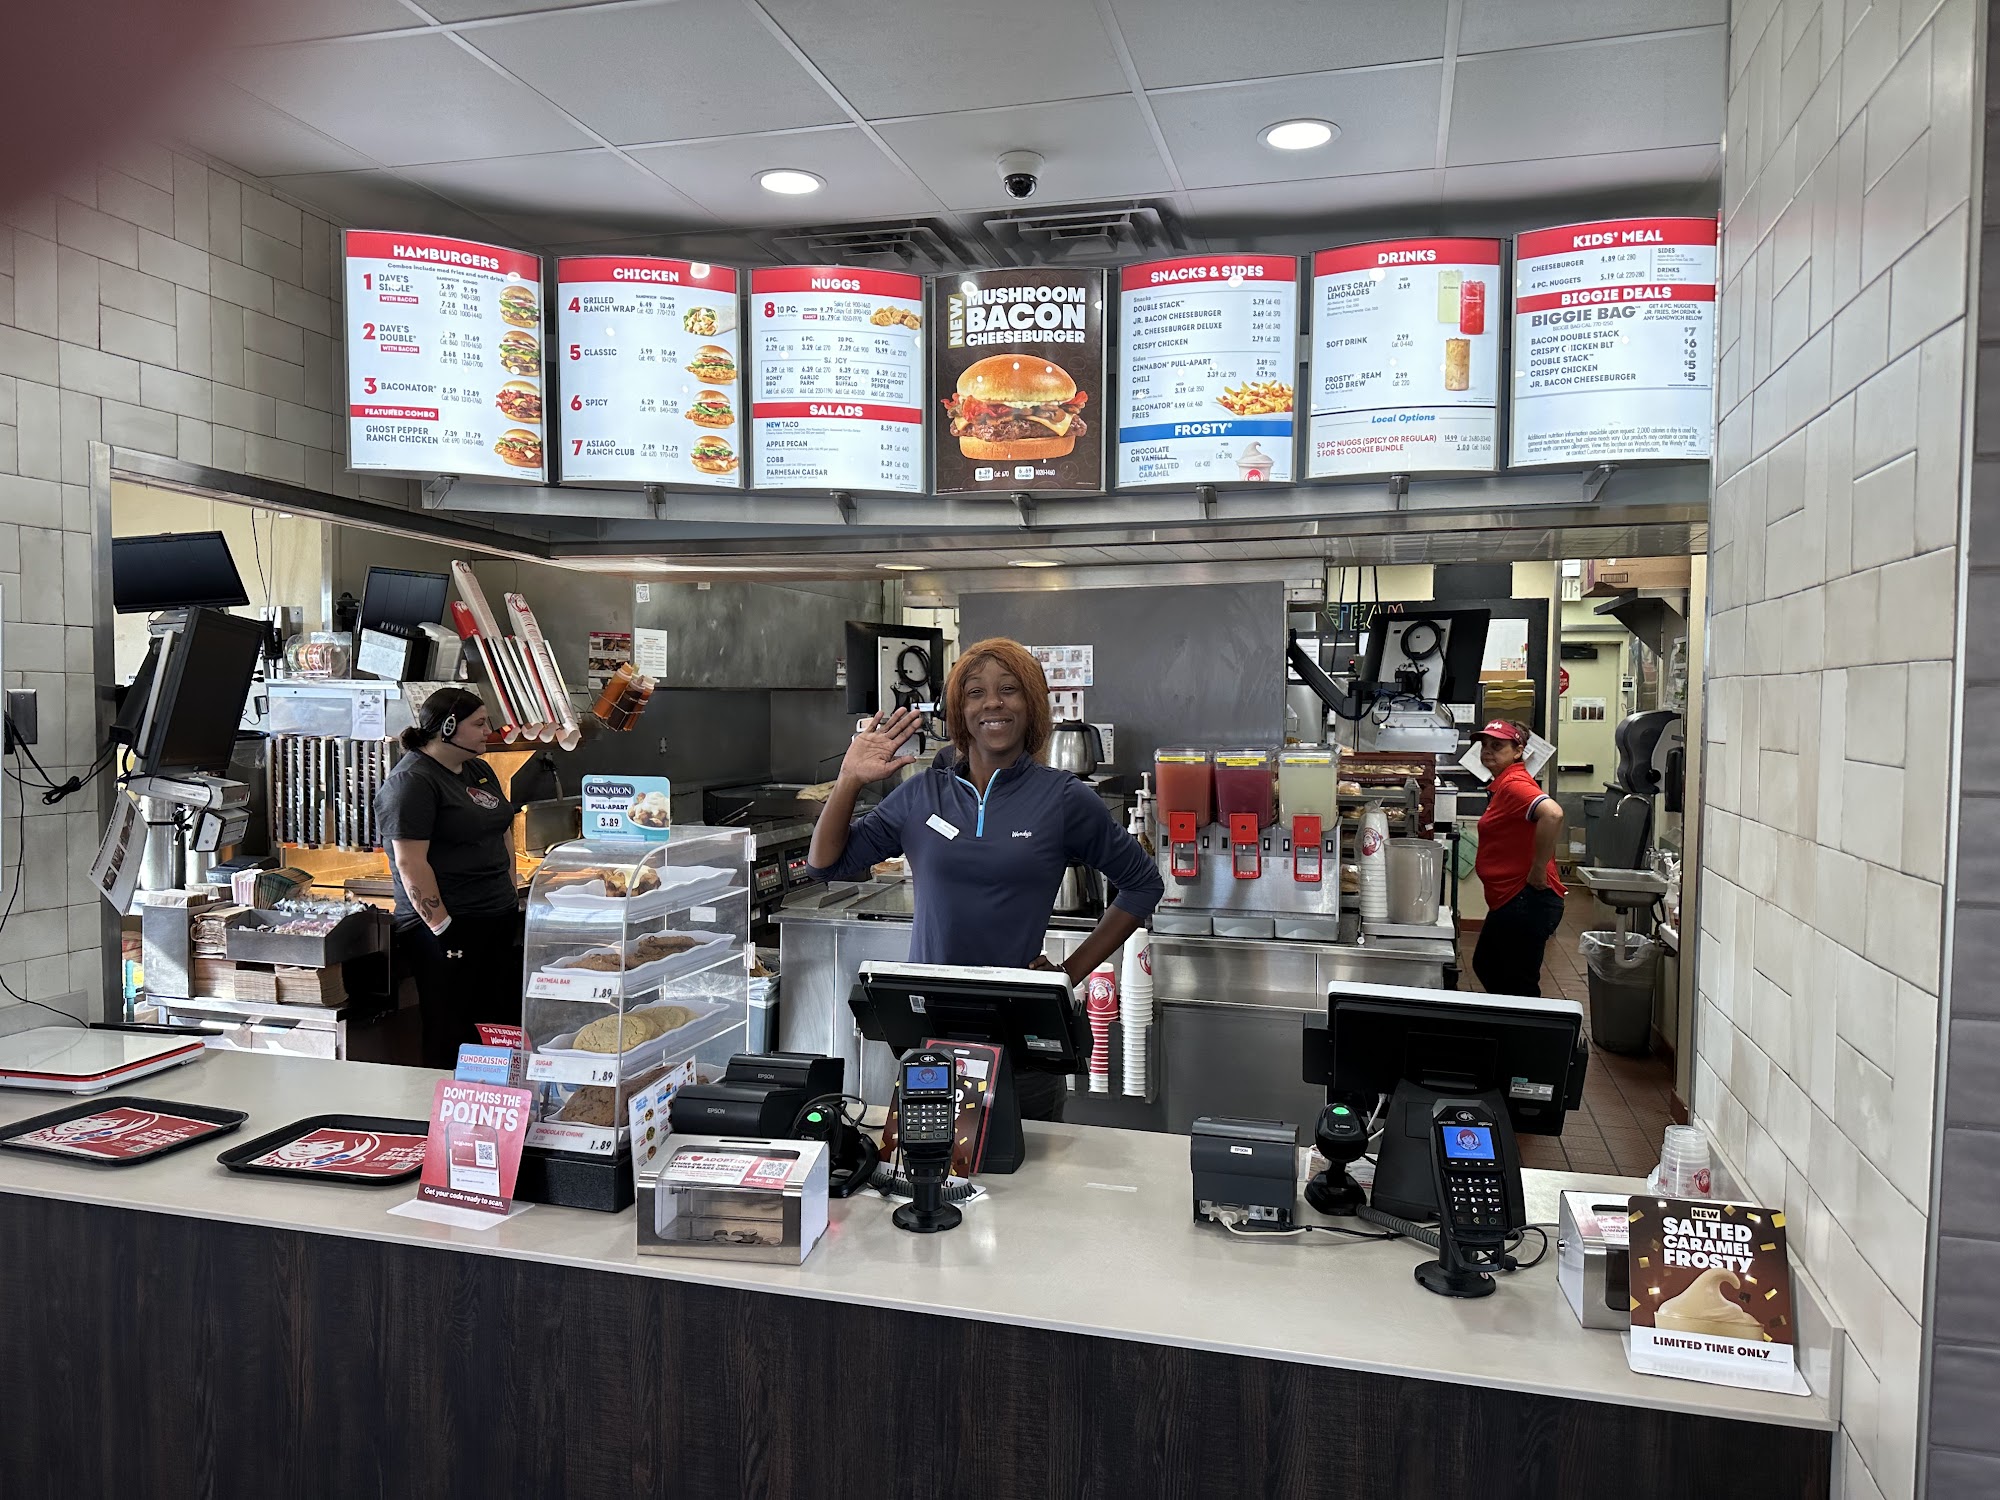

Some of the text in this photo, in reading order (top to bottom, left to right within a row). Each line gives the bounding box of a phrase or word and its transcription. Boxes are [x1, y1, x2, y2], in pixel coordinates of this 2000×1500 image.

[1573, 230, 1663, 248] KIDS' MEAL
[393, 245, 499, 269] HAMBURGERS
[1378, 250, 1436, 264] DRINKS
[451, 268, 465, 276] fries
[1531, 260, 1584, 272] CHEESEBURGER
[379, 274, 409, 282] DAVE'S
[613, 268, 679, 282] CHICKEN
[1151, 265, 1263, 283] SNACKS & SIDES
[363, 274, 371, 290] 1
[811, 278, 860, 290] NUGGS
[1328, 281, 1377, 293] DAVE'S CRAFT
[1550, 277, 1582, 287] NUGGETS
[967, 286, 1085, 306] MUSHROOM
[1328, 289, 1370, 300] LEMONADES
[1562, 287, 1672, 305] BIGGIE DEALS
[568, 297, 580, 313] 4
[764, 302, 775, 318] 8
[950, 298, 962, 345] NEW
[967, 303, 1085, 333] BACON
[1145, 314, 1167, 323] BACON
[1169, 310, 1222, 320] CHEESEBURGER
[1532, 306, 1636, 327] BIGGIE BAG
[363, 323, 375, 340] 2
[380, 324, 409, 333] DAVE'S
[1145, 324, 1195, 335] CHEESEBURGER
[1685, 327, 1696, 336] $7
[966, 330, 1085, 346] CHEESEBURGER
[1326, 337, 1368, 348] SOFT DRINK
[1531, 330, 1619, 345] BACON DOUBLE STACK
[1685, 339, 1697, 348] $6
[1133, 338, 1188, 350] CRISPY CHICKEN
[570, 345, 581, 360] 5
[1171, 359, 1211, 368] PULL-APART
[1684, 360, 1696, 369] $5
[1531, 364, 1598, 377] CRISPY CHICKEN
[1684, 372, 1696, 381] $5
[1345, 380, 1365, 388] BREW
[1544, 378, 1572, 386] BACON
[1574, 373, 1636, 383] CHEESEBURGER
[364, 378, 377, 394] 3
[571, 395, 582, 411] 6
[585, 399, 608, 407] SPICY
[365, 408, 435, 418] FEATURED COMBO
[810, 405, 863, 416] SALADS
[1372, 414, 1435, 423] Local Options
[366, 425, 428, 435] GHOST PEPPER
[366, 434, 438, 444] RANCH CHICKEN
[587, 440, 616, 448] ASIAGO
[1337, 439, 1362, 447] NUGGS
[1363, 437, 1387, 446] (SPICY
[572, 440, 583, 455] 7
[1131, 446, 1169, 455] CHOCOLATE
[1376, 444, 1403, 452] BUNDLE
[587, 786, 631, 794] CINNABON
[601, 818, 618, 826] 3.89
[593, 988, 612, 998] 1.89
[461, 1055, 508, 1065] FUNDRAISING
[592, 1071, 613, 1081] 1.89
[444, 1087, 521, 1107] DON'T MISS THE
[440, 1099, 519, 1131] POINTS
[536, 1128, 565, 1136] CHOCOLATE
[590, 1141, 611, 1150] 1.89
[424, 1187, 435, 1195] Get
[450, 1192, 463, 1200] code
[464, 1195, 480, 1204] ready
[488, 1199, 503, 1207] scan.
[1693, 1209, 1719, 1219] NEW
[1663, 1217, 1752, 1242] SALTED
[1663, 1235, 1753, 1257] CARAMEL
[1664, 1249, 1752, 1273] FROSTY
[1654, 1337, 1770, 1359] LIMITED TIME ONLY
